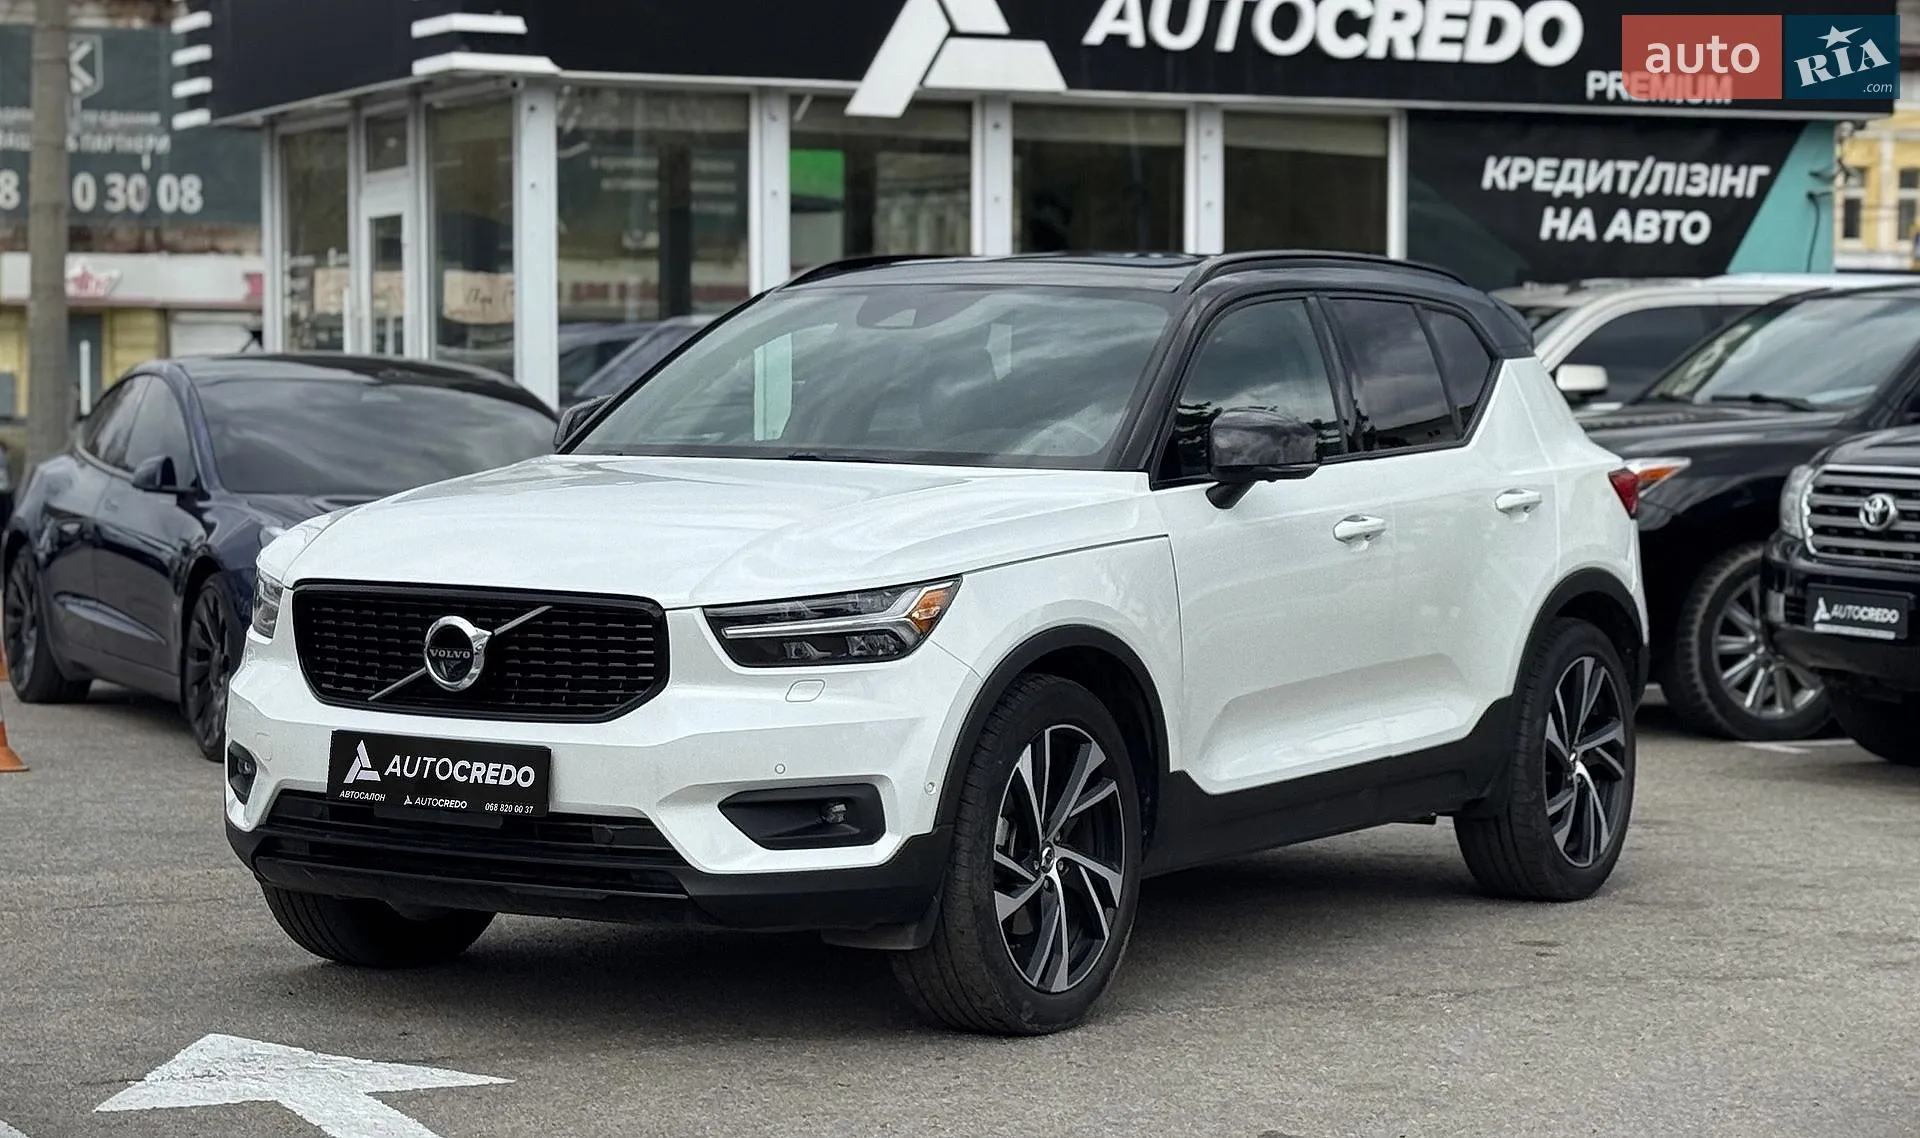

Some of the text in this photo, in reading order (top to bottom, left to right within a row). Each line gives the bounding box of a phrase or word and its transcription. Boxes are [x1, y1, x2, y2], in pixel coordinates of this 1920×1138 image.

[1082, 0, 1584, 67] AUTOCREDO
[1586, 70, 1734, 105] PREMIUM
[103, 172, 149, 213] 30
[157, 173, 204, 214] 08
[1481, 155, 1771, 198] КРЕДИТ/ЛІЗІНГ
[1539, 206, 1712, 245] НА АВТО
[429, 648, 471, 659] VOLVO
[384, 754, 536, 788] AUTOCREDO
[339, 789, 386, 802] АВТОСАЛОН
[414, 796, 468, 810] AUTOCREDO
[485, 802, 498, 812] 068
